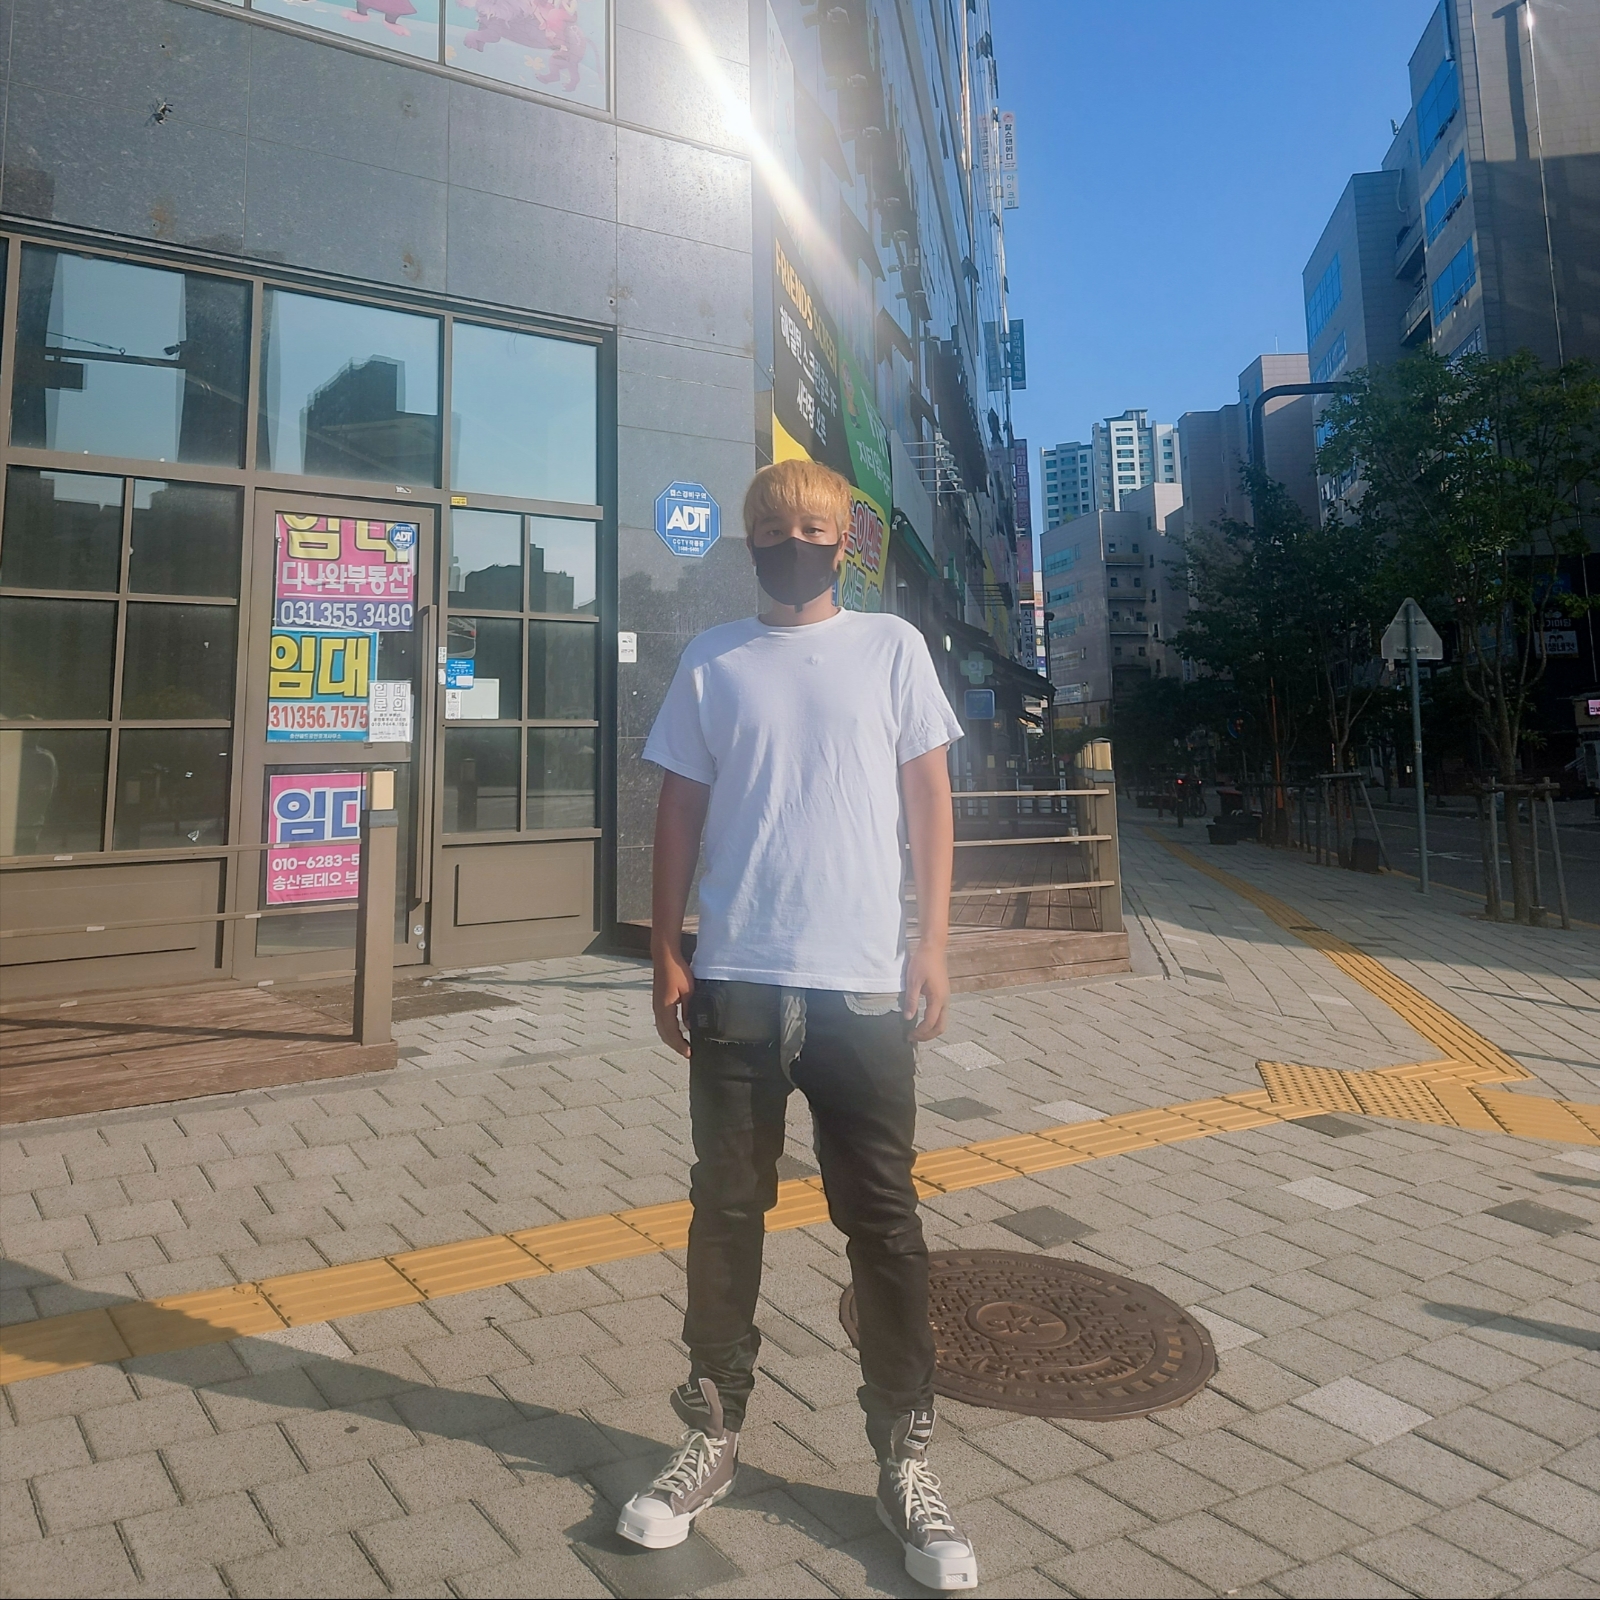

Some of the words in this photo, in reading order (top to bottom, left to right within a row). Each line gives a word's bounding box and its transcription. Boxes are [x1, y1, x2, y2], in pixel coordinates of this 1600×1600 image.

[775, 236, 813, 331] FRIENDS
[797, 377, 815, 430] 새단장
[815, 406, 827, 447] 오픈
[667, 505, 710, 533] ADT
[393, 531, 413, 542] ADT
[282, 561, 411, 595] 다나와부동산
[280, 600, 413, 627] 031.355.3480
[270, 634, 370, 699] 임대
[967, 660, 984, 678] 약
[272, 871, 342, 891] 송산로데오
